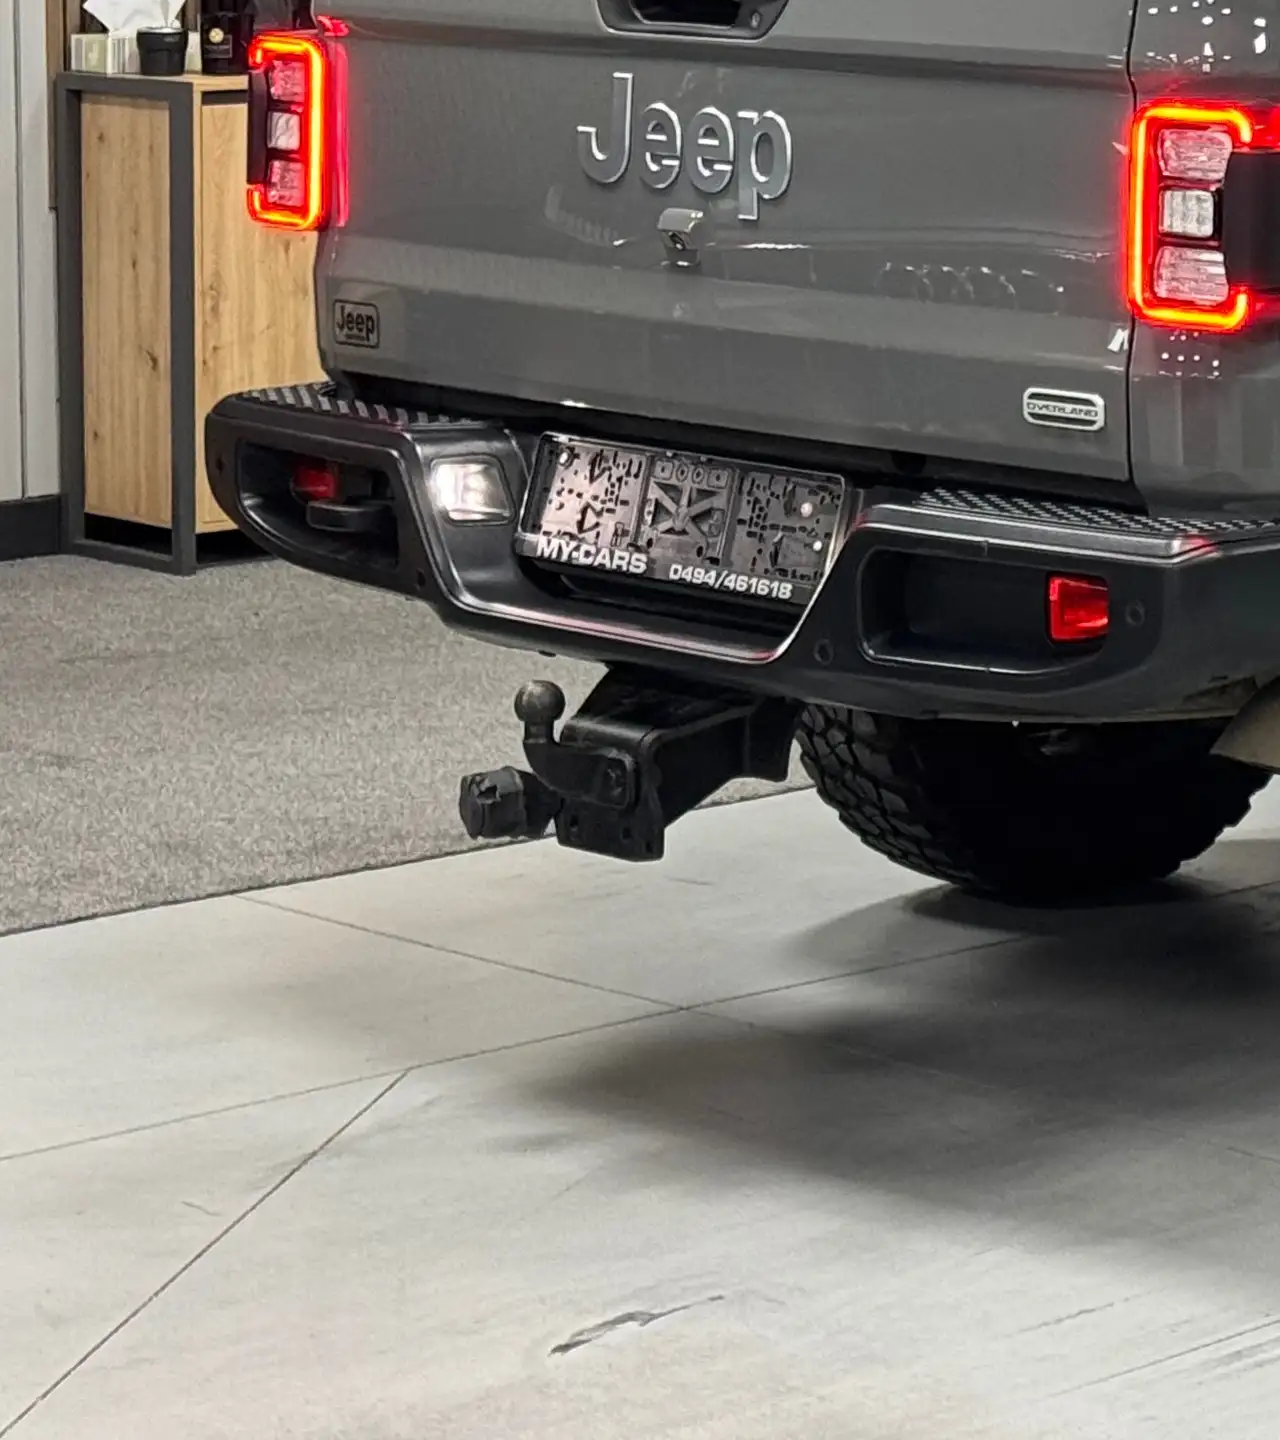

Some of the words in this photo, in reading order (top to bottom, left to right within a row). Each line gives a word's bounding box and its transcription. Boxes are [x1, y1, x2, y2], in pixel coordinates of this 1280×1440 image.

[577, 72, 792, 220] Jeep
[336, 304, 375, 342] Jeep
[668, 563, 794, 600] 0494/461618
